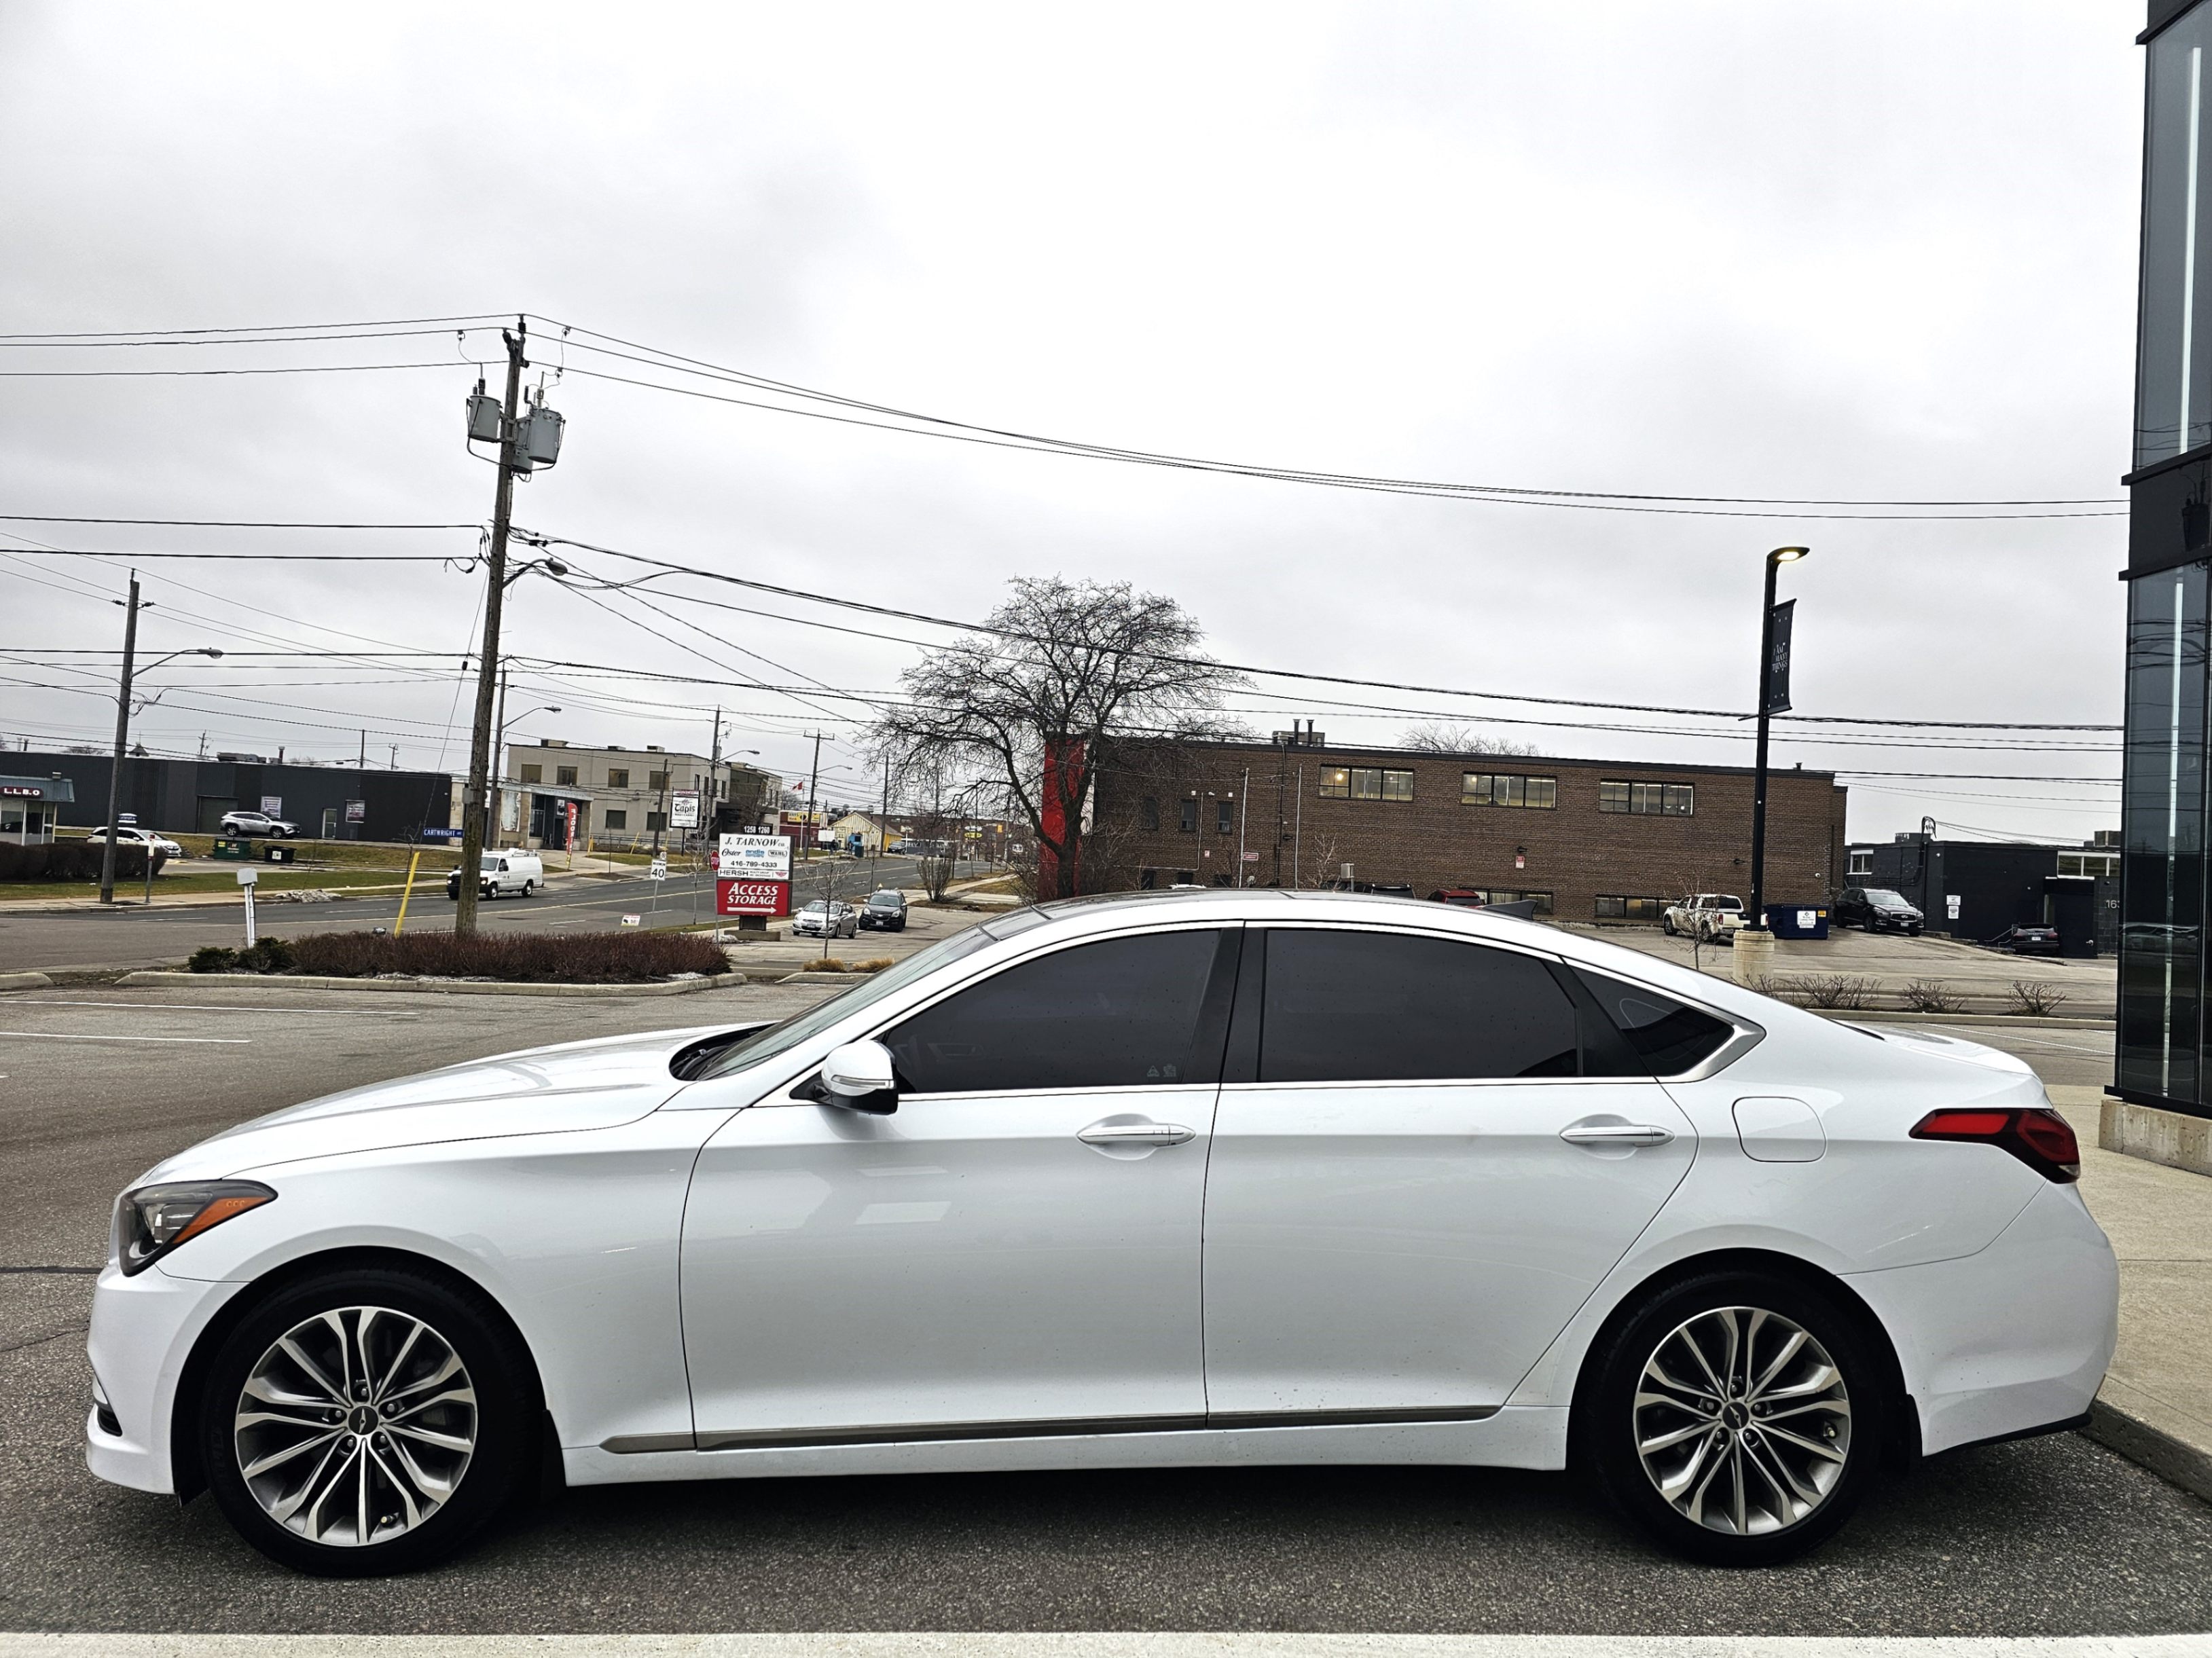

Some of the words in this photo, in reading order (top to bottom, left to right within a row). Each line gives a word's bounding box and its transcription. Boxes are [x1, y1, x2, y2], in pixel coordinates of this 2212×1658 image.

[424, 829, 455, 837] CARTWRIGHT
[744, 826, 756, 834] 1258
[758, 826, 770, 834] 1260
[725, 837, 733, 845] J.
[736, 837, 779, 847] TARNOW
[721, 848, 742, 857] Oster
[651, 868, 665, 878] 40
[727, 895, 778, 905] STORAGE
[2105, 900, 2120, 908] 16
